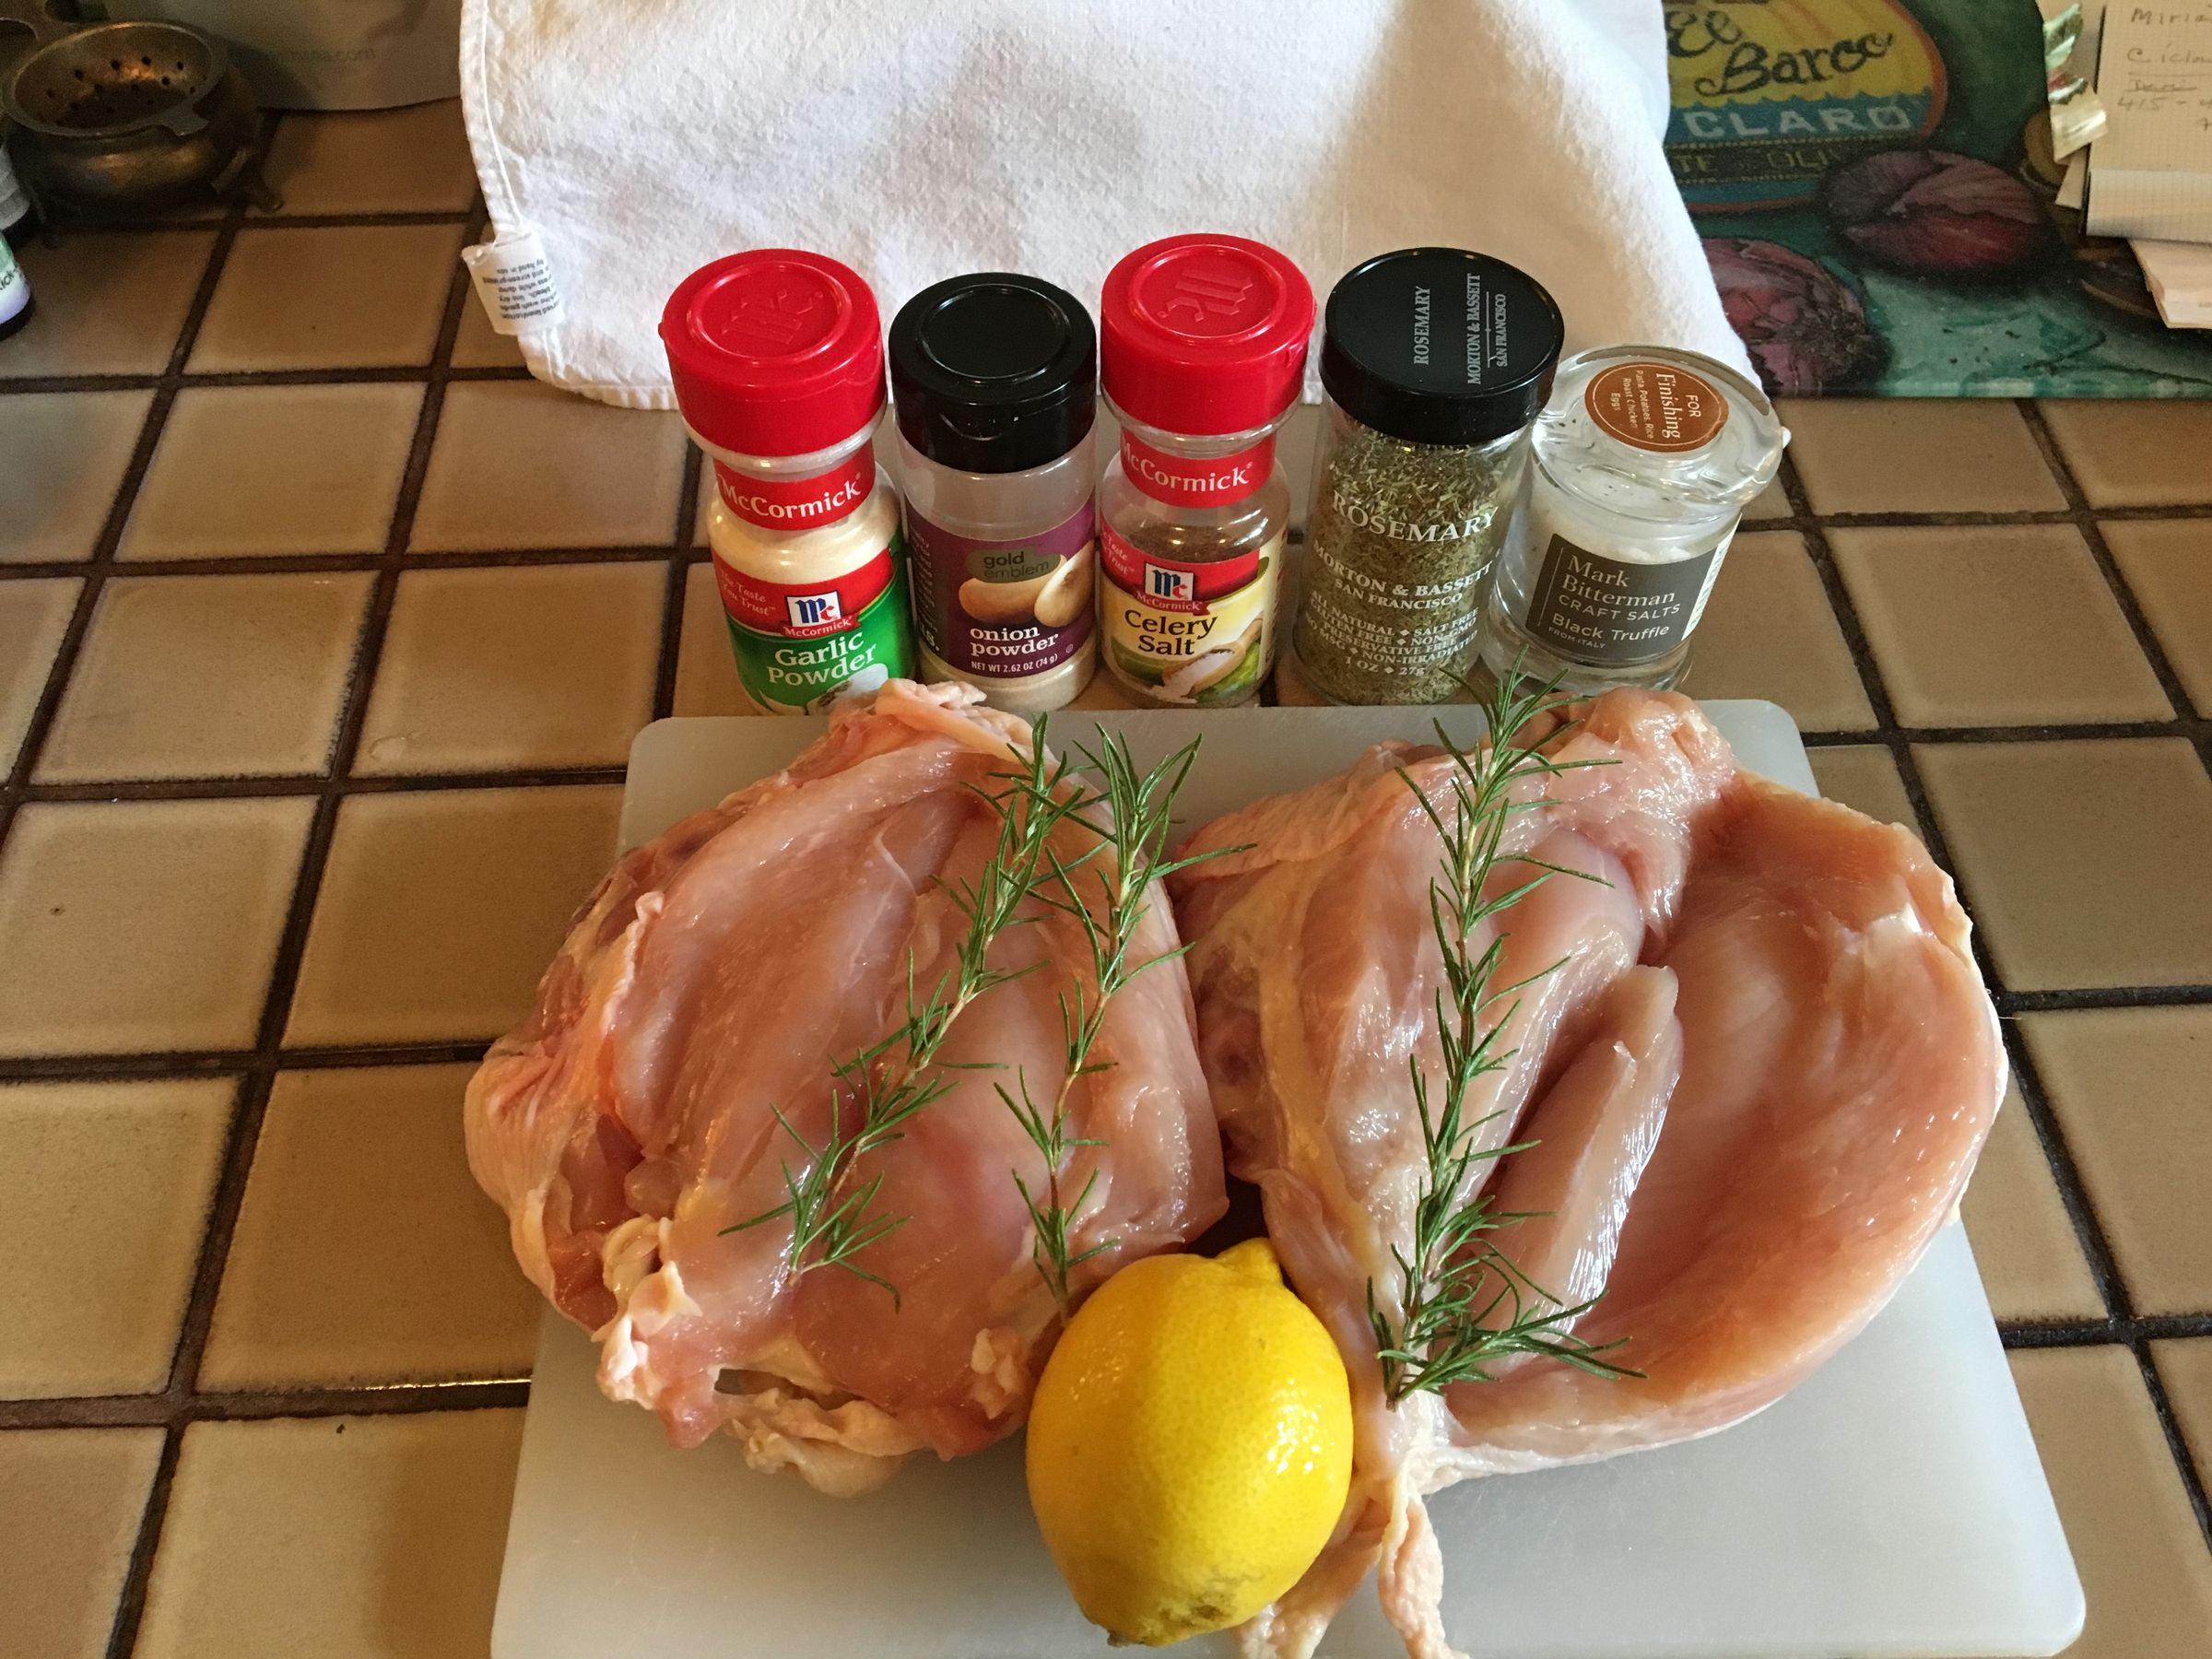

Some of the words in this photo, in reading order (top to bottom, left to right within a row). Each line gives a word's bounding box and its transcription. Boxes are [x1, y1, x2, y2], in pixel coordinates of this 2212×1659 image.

[1684, 106, 1912, 137] CLARO
[1467, 273, 1480, 321] BASSETT
[1414, 286, 1430, 365] ROSEMARY
[1467, 323, 1480, 333] &
[1495, 293, 1507, 347] FRANCISCO
[1467, 334, 1481, 384] MORTON
[1496, 347, 1508, 367] SAN
[1622, 377, 1633, 398] Roast
[1610, 393, 1621, 411] Eggs
[1656, 372, 1683, 439] Finishing
[1686, 394, 1701, 418] FOR
[718, 473, 861, 519] McCormick
[1334, 489, 1499, 542] ROSEMARY
[983, 551, 1024, 569] gold
[983, 560, 1049, 579] emblem
[1314, 539, 1386, 593] MORTON
[1392, 584, 1409, 596] &
[1415, 560, 1493, 596] BASSETT
[1568, 554, 1630, 588] Mark
[736, 582, 766, 603] Taste
[1134, 591, 1202, 610] McCormick
[1335, 578, 1364, 599] SAN
[1368, 593, 1463, 609] FRANCISCO
[1562, 573, 1676, 606] Bitterman
[1332, 606, 1395, 636] NATURAL
[1414, 623, 1449, 637] SALT
[1452, 606, 1478, 629] FREE
[1559, 594, 1621, 620] CRAFT
[1626, 603, 1681, 621] SALTS
[783, 618, 852, 637] McCormick
[970, 626, 1041, 641] onion
[1124, 609, 1218, 640] Celery
[1324, 621, 1421, 654] PRESERVATIVE
[1357, 629, 1393, 645] FREE
[1547, 626, 1576, 643] FROM
[1577, 637, 1606, 649] ITALY
[1552, 612, 1606, 640] Black
[1610, 625, 1670, 641] Truffle
[774, 631, 865, 666] Garlic
[970, 633, 1059, 657] powder
[1137, 634, 1194, 655] Salt
[767, 643, 877, 687] Powder
[971, 660, 985, 671] NET
[988, 663, 1001, 673] WT
[1003, 662, 1021, 673] 2.62
[1023, 661, 1034, 671] OZ
[1357, 660, 1380, 672] OZ
[1399, 666, 1426, 677] 27g
